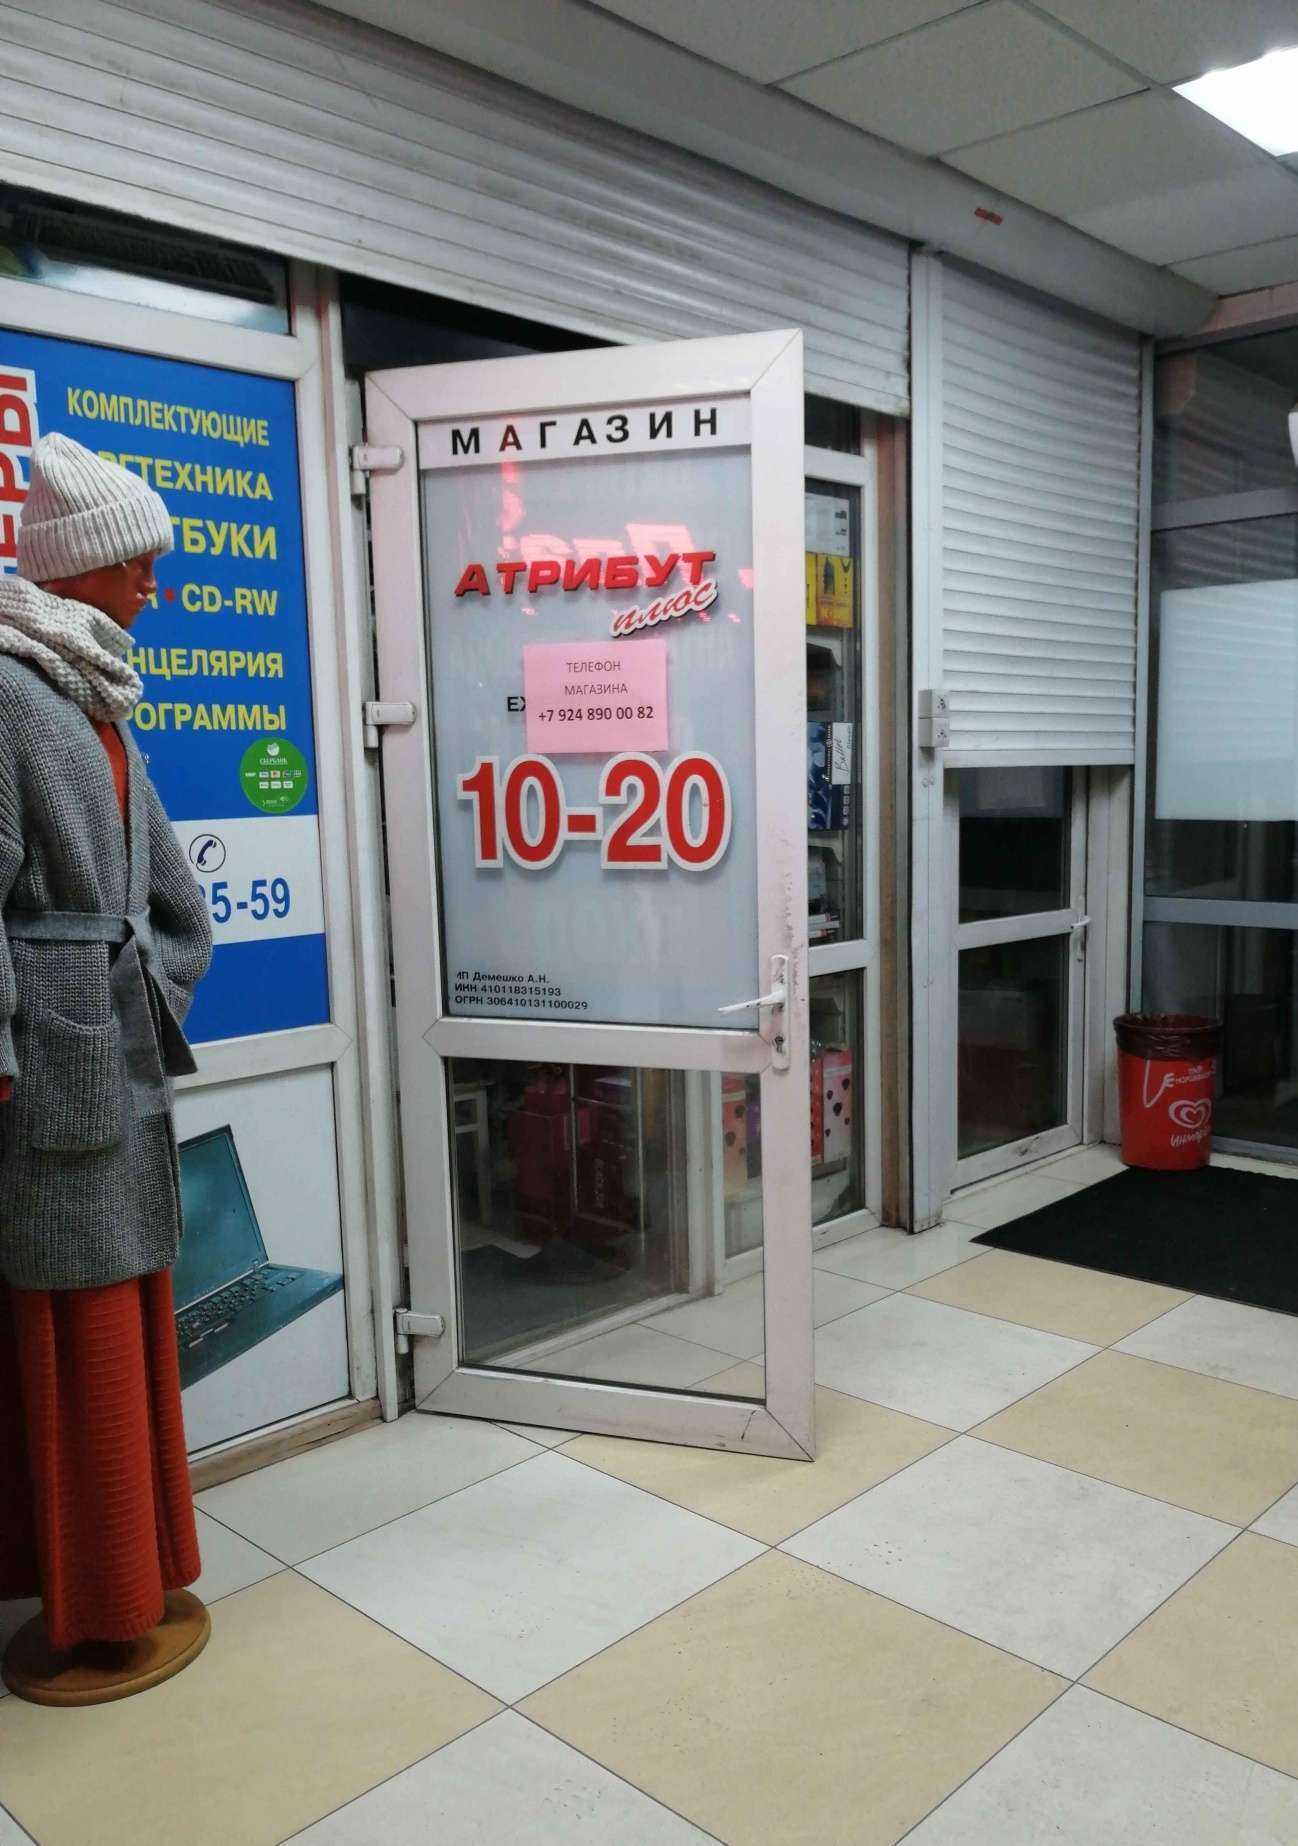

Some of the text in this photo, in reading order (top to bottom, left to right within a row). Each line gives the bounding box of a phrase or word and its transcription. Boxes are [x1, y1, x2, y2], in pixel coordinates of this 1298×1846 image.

[67, 387, 270, 447] КОМПЛЕКТУЮЩИЕ
[451, 407, 718, 455] МАГАЗИН
[454, 551, 716, 596] АТРИБУТ
[181, 583, 278, 617] CD-RW
[566, 660, 621, 673] ТЕЛЕФОН
[564, 682, 628, 696] МАГАЗИНА
[124, 702, 287, 732] ОГРАММЫ
[538, 705, 654, 722] +7 924 890 00 82
[458, 752, 730, 869] 10-20
[472, 971, 524, 983] Демешко
[527, 974, 550, 984] А.Н.
[454, 983, 561, 997] ИНН 410118315193
[454, 995, 483, 1005] ОГРН
